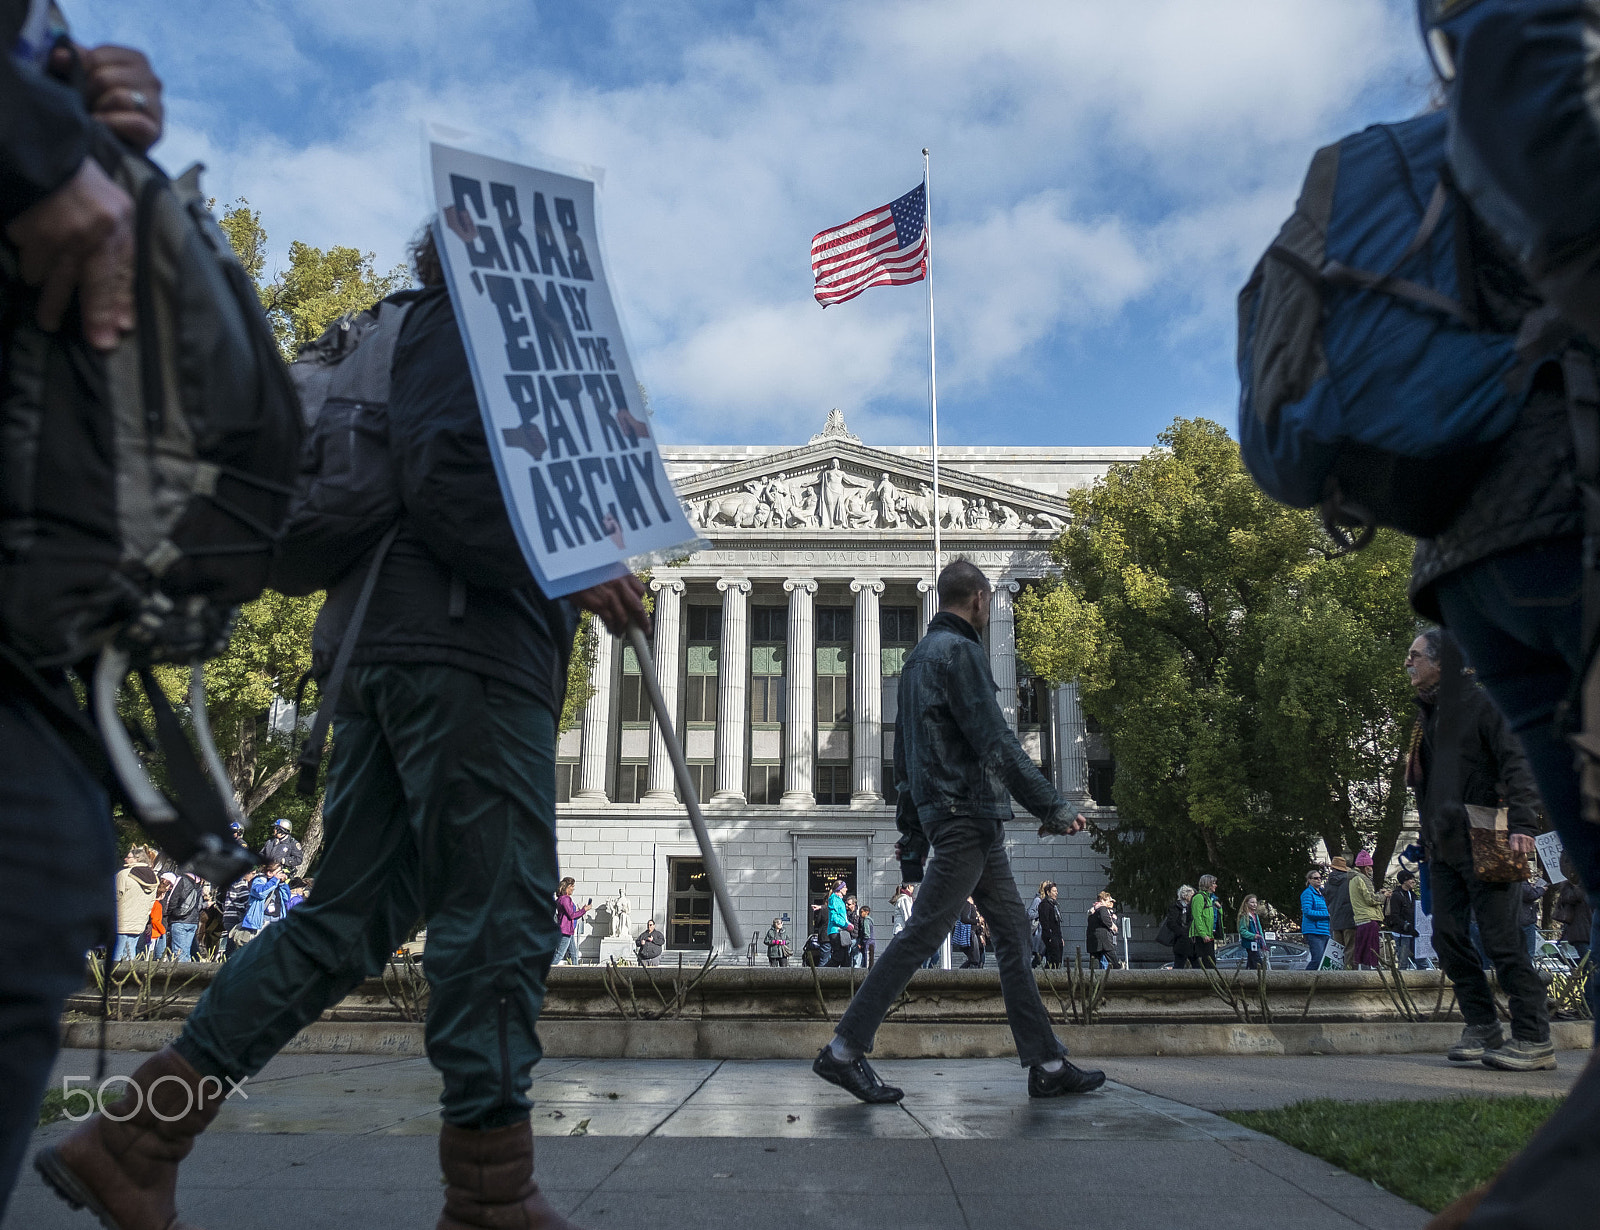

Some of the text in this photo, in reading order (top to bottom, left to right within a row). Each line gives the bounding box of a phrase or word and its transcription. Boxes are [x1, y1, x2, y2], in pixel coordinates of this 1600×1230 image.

[449, 173, 594, 282] GRAB
[559, 283, 592, 332] BY
[578, 337, 615, 371] THE
[504, 373, 641, 461] PATRI
[529, 451, 671, 554] ARCHY
[715, 551, 736, 562] ME
[750, 551, 780, 562] MEN
[794, 551, 815, 562] TO
[825, 551, 878, 563] MATCH
[890, 551, 912, 562] MY
